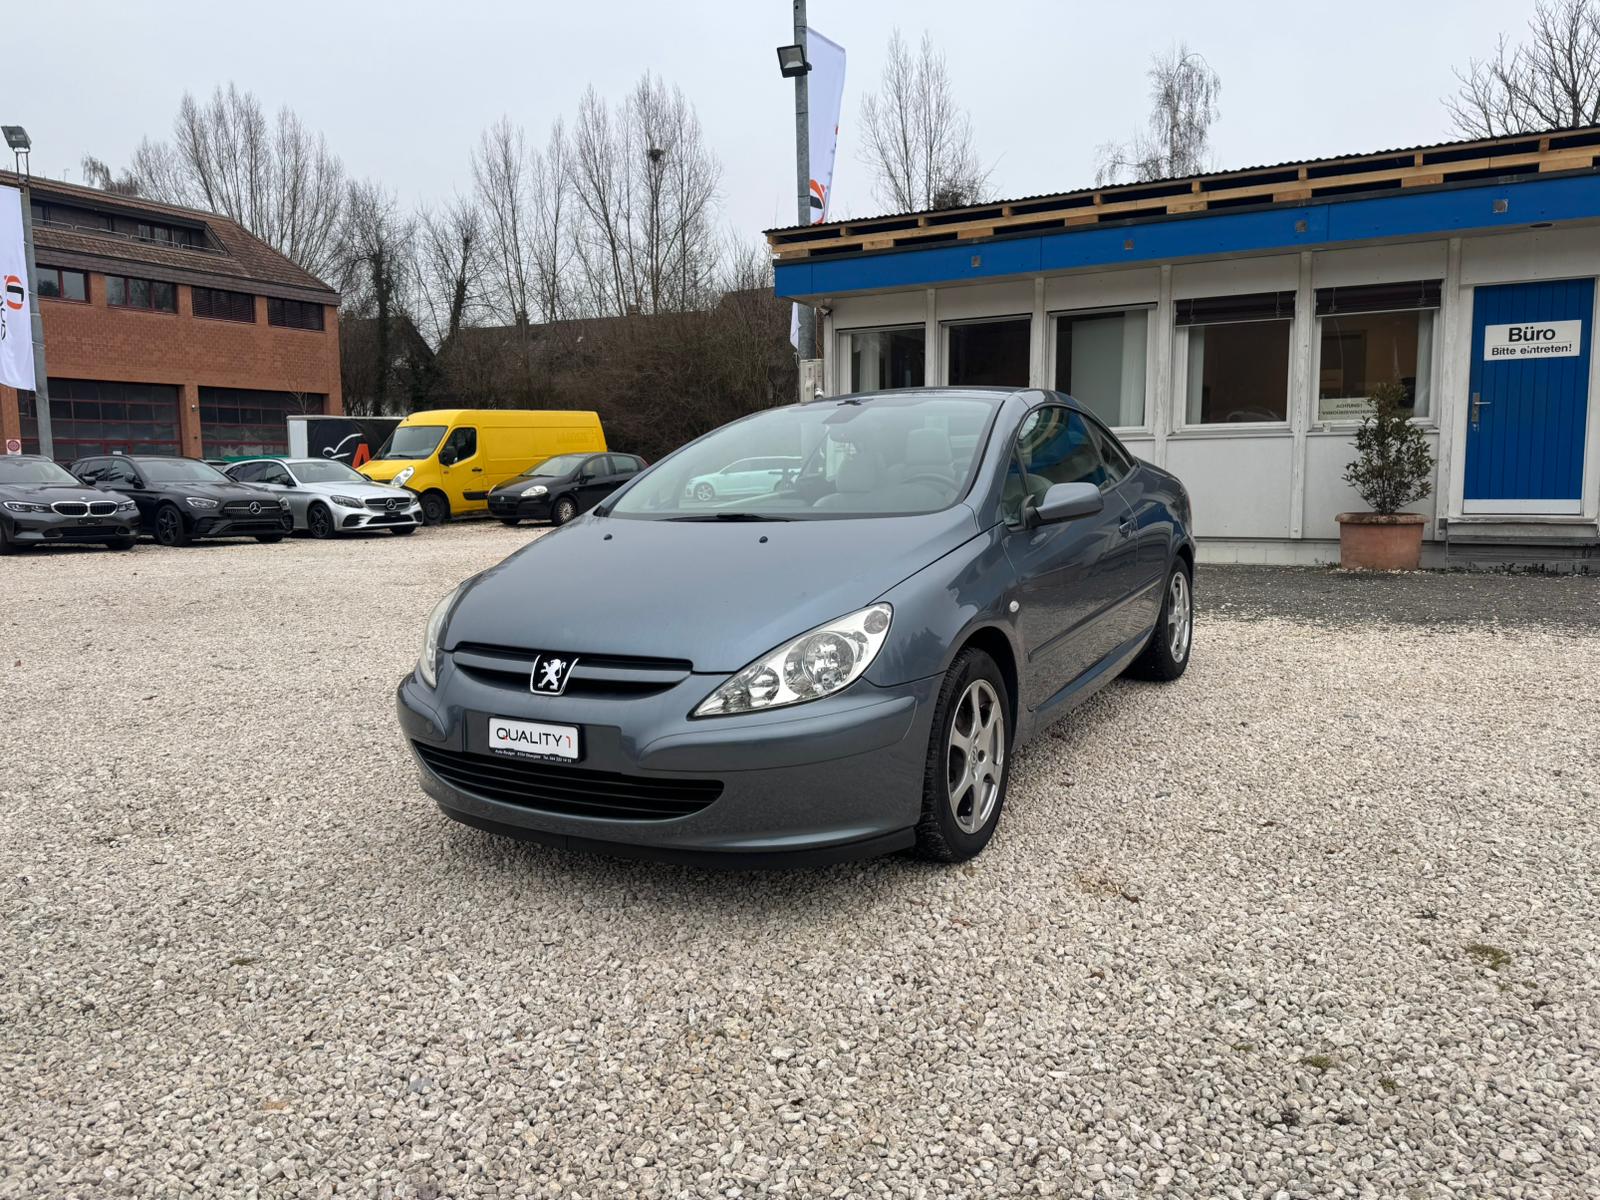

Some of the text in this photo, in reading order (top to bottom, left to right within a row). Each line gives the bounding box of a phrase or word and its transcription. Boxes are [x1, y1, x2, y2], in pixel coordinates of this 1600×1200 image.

[1508, 326, 1556, 342] Büro
[1491, 343, 1572, 356] Bitte eintreten!
